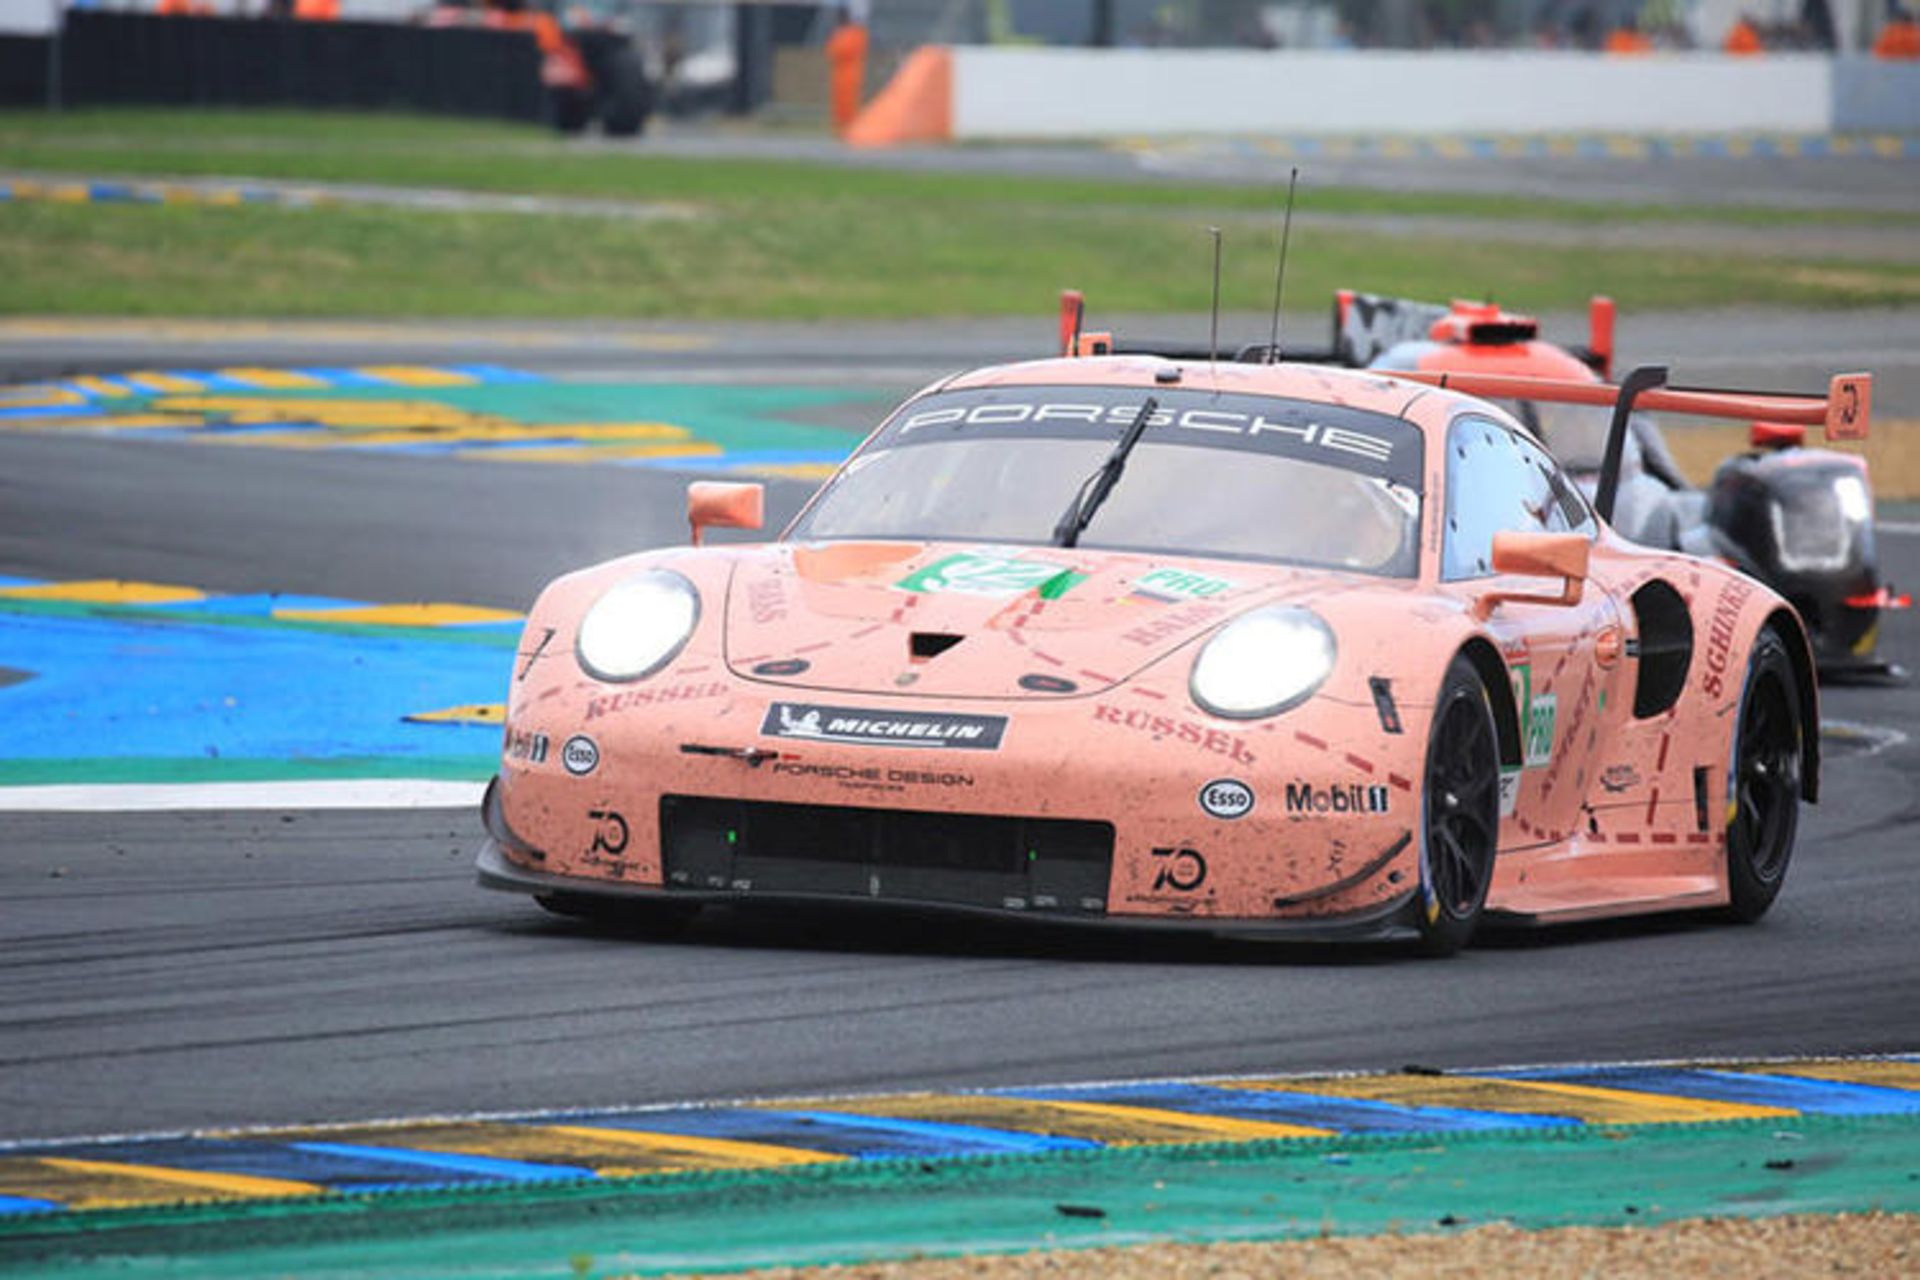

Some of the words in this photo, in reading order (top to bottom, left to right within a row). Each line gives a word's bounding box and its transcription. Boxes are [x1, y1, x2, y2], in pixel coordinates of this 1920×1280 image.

[901, 404, 1394, 461] PORSCHE
[1140, 567, 1229, 595] PRO
[827, 717, 984, 739] MICHELIN
[773, 762, 881, 781] PORSCHE
[887, 769, 975, 787] DESIGN
[1207, 788, 1248, 808] Esso
[1286, 783, 1366, 813] Mobil
[1151, 847, 1207, 891] 70
